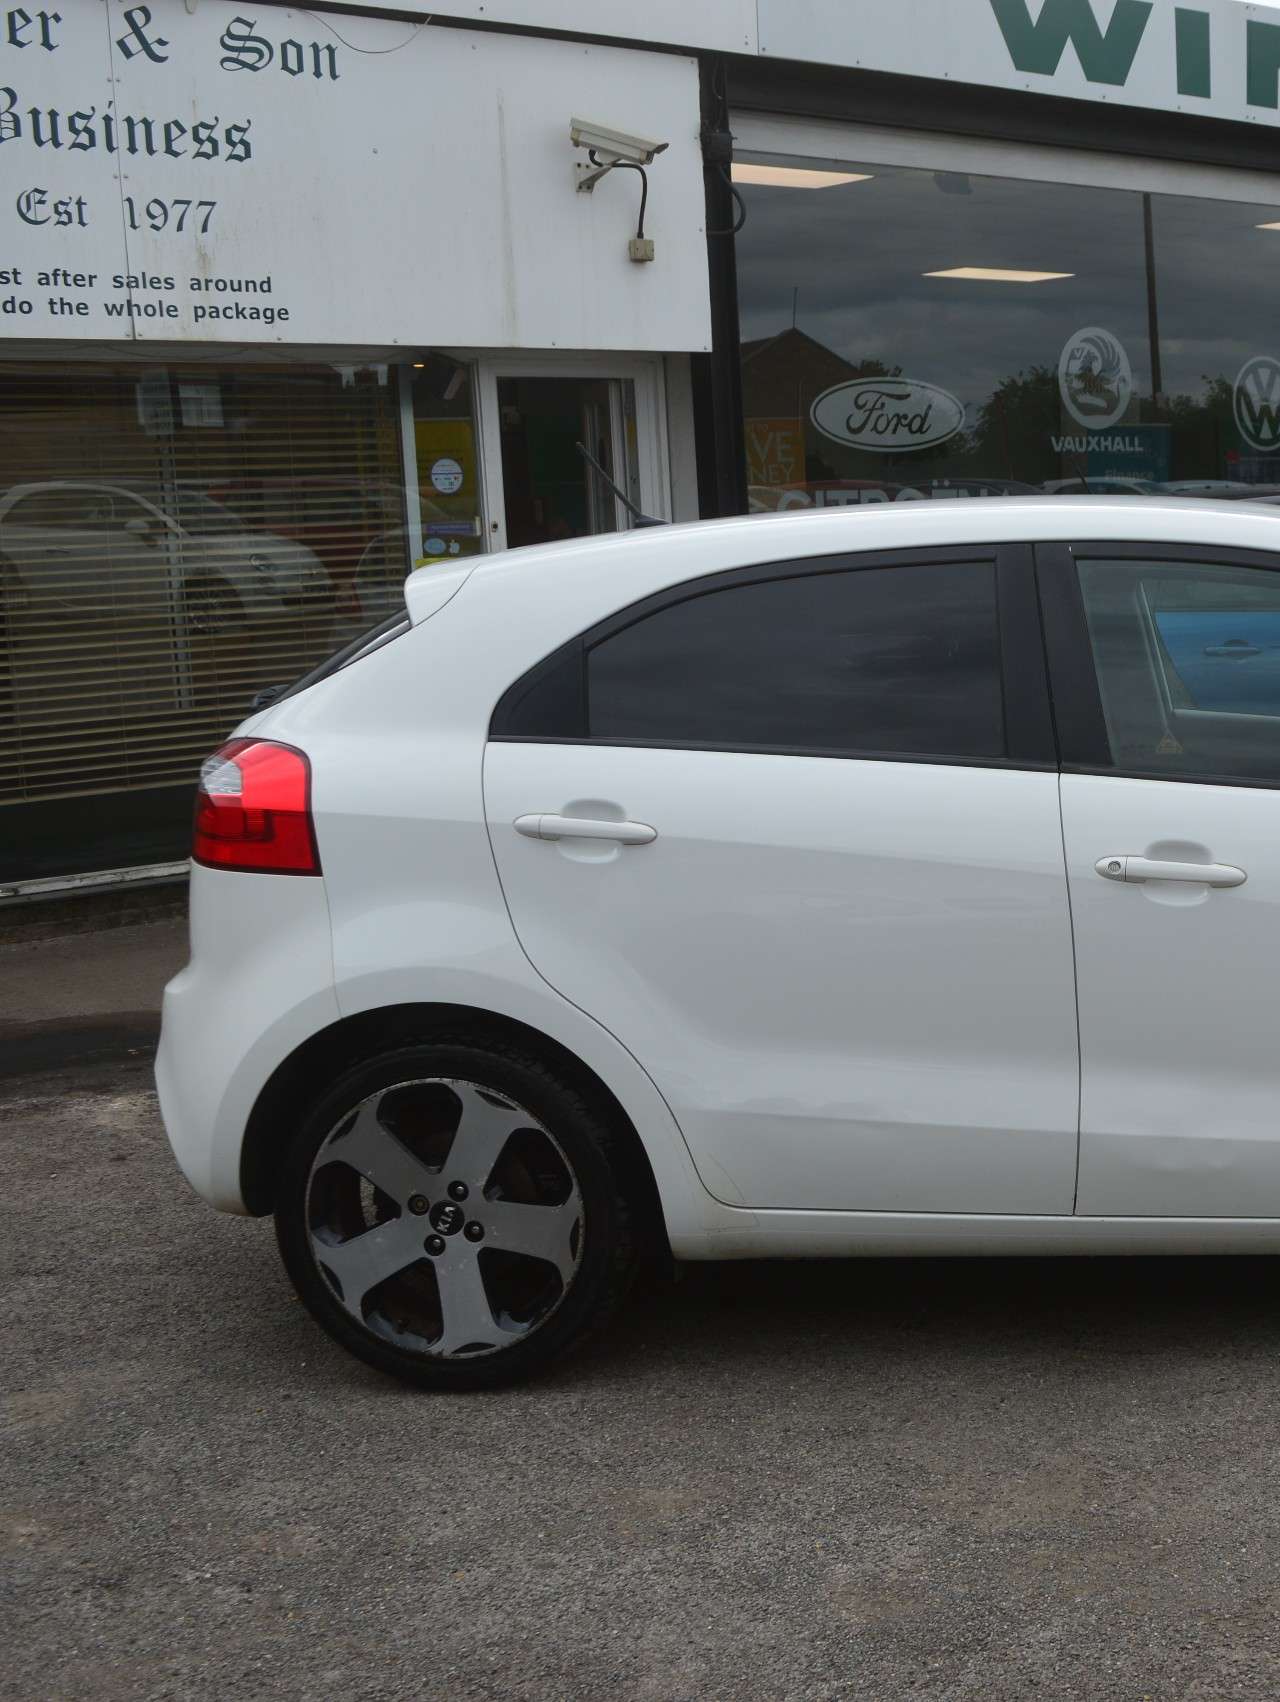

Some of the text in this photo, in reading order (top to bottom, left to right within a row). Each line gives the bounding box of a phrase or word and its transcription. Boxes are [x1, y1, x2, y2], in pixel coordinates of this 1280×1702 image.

[7, 5, 341, 81] er & Son
[16, 187, 218, 234] Est 1977
[37, 268, 98, 288] after
[112, 272, 176, 291] sales
[189, 276, 272, 294] around
[2, 295, 290, 325] do the whole package
[845, 389, 933, 436] Ford
[746, 431, 796, 464] VE
[1050, 435, 1145, 453] VAUXHALL
[436, 1206, 456, 1232] KIA
